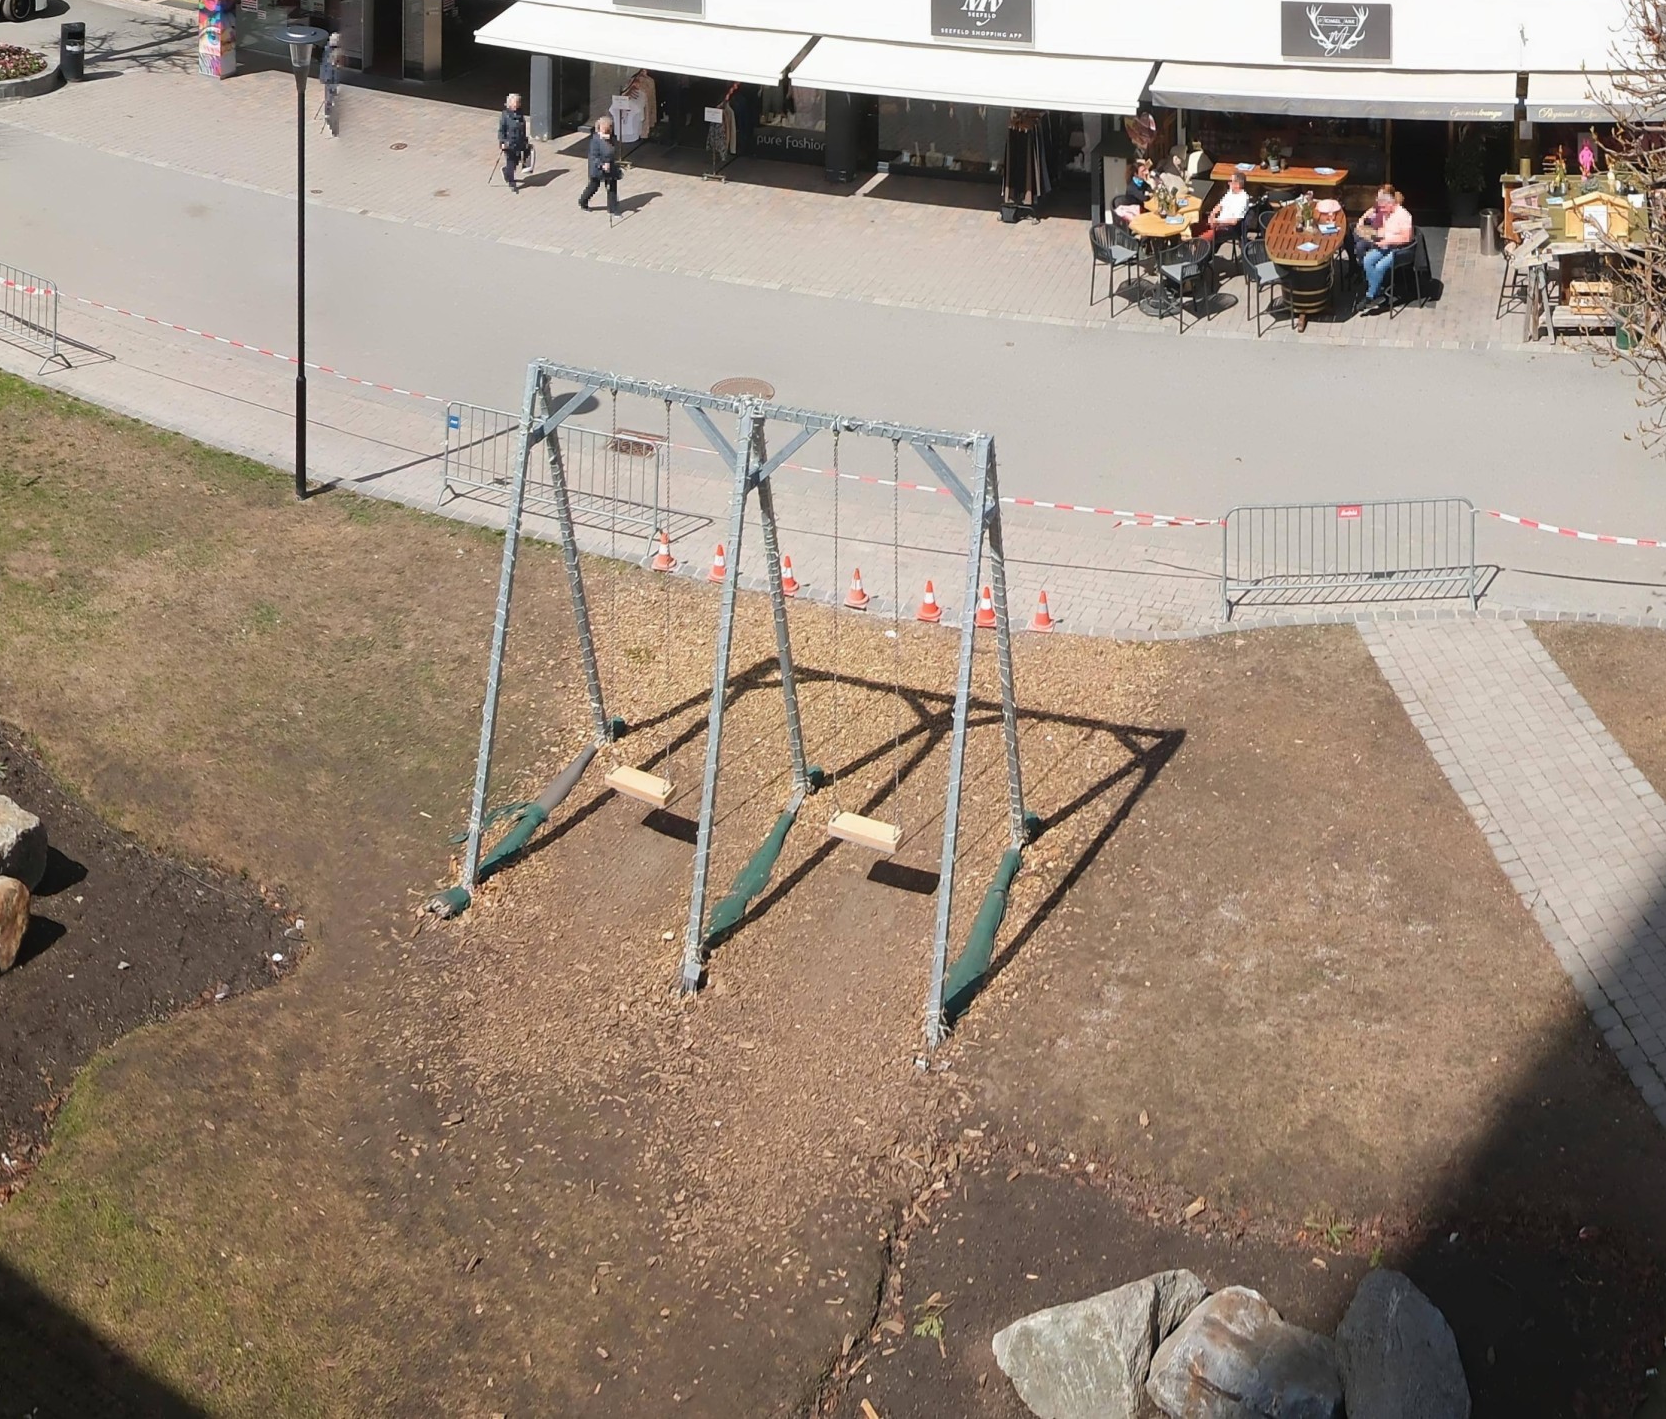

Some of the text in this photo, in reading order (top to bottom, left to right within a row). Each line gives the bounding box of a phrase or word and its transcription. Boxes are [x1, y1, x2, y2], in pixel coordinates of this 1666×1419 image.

[967, 11, 997, 19] SEEFELD
[940, 27, 970, 35] SEEFELD
[971, 29, 1007, 38] SHOPPING
[756, 134, 783, 146] pure
